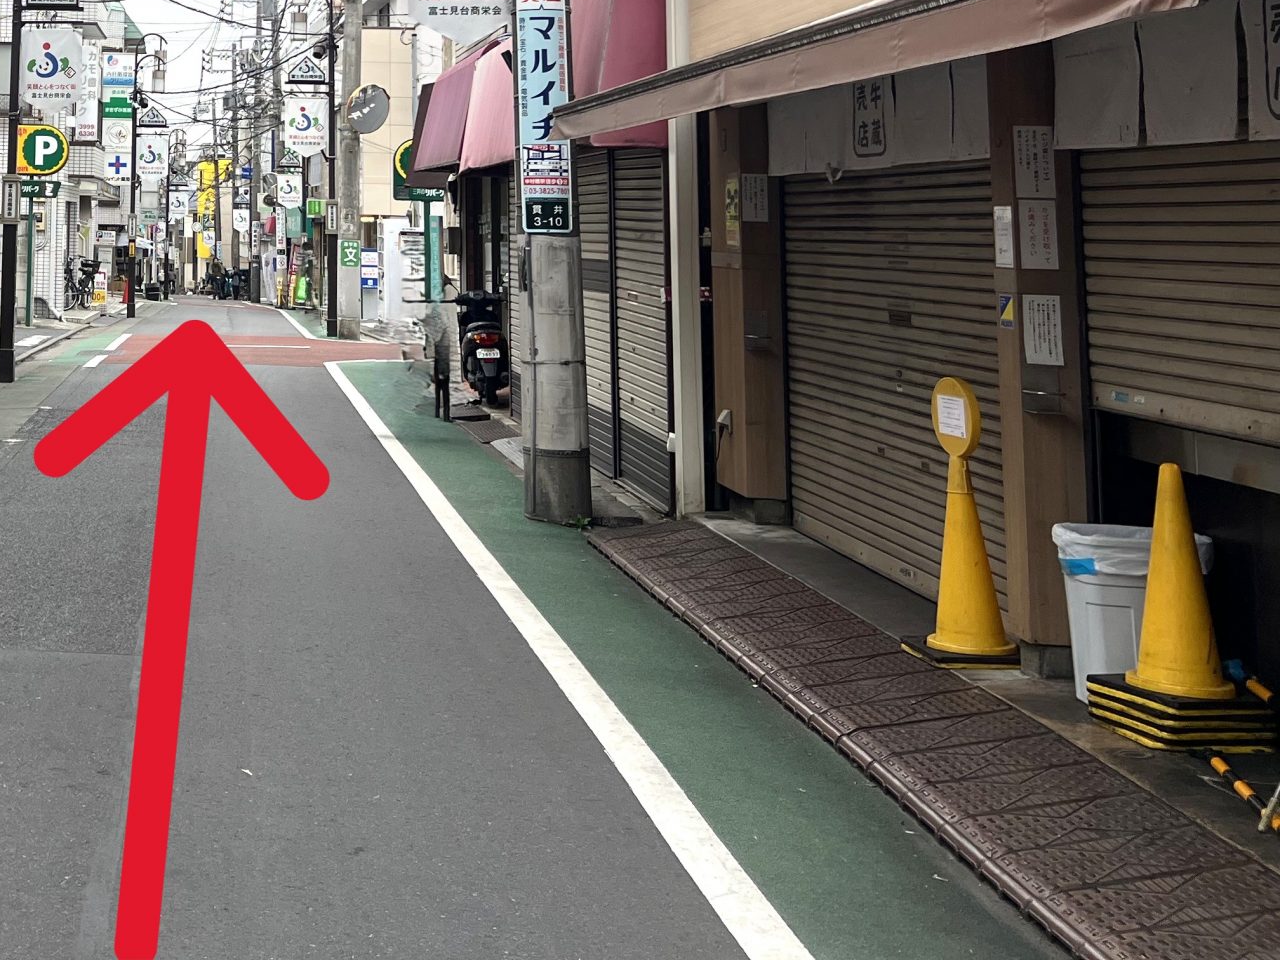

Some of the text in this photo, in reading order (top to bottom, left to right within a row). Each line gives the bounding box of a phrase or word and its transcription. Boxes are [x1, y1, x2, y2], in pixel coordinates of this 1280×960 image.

[428, 5, 503, 16] 富士見台商栄会
[528, 16, 557, 141] マルイチ
[34, 135, 58, 166] P
[533, 216, 563, 227] 3-10
